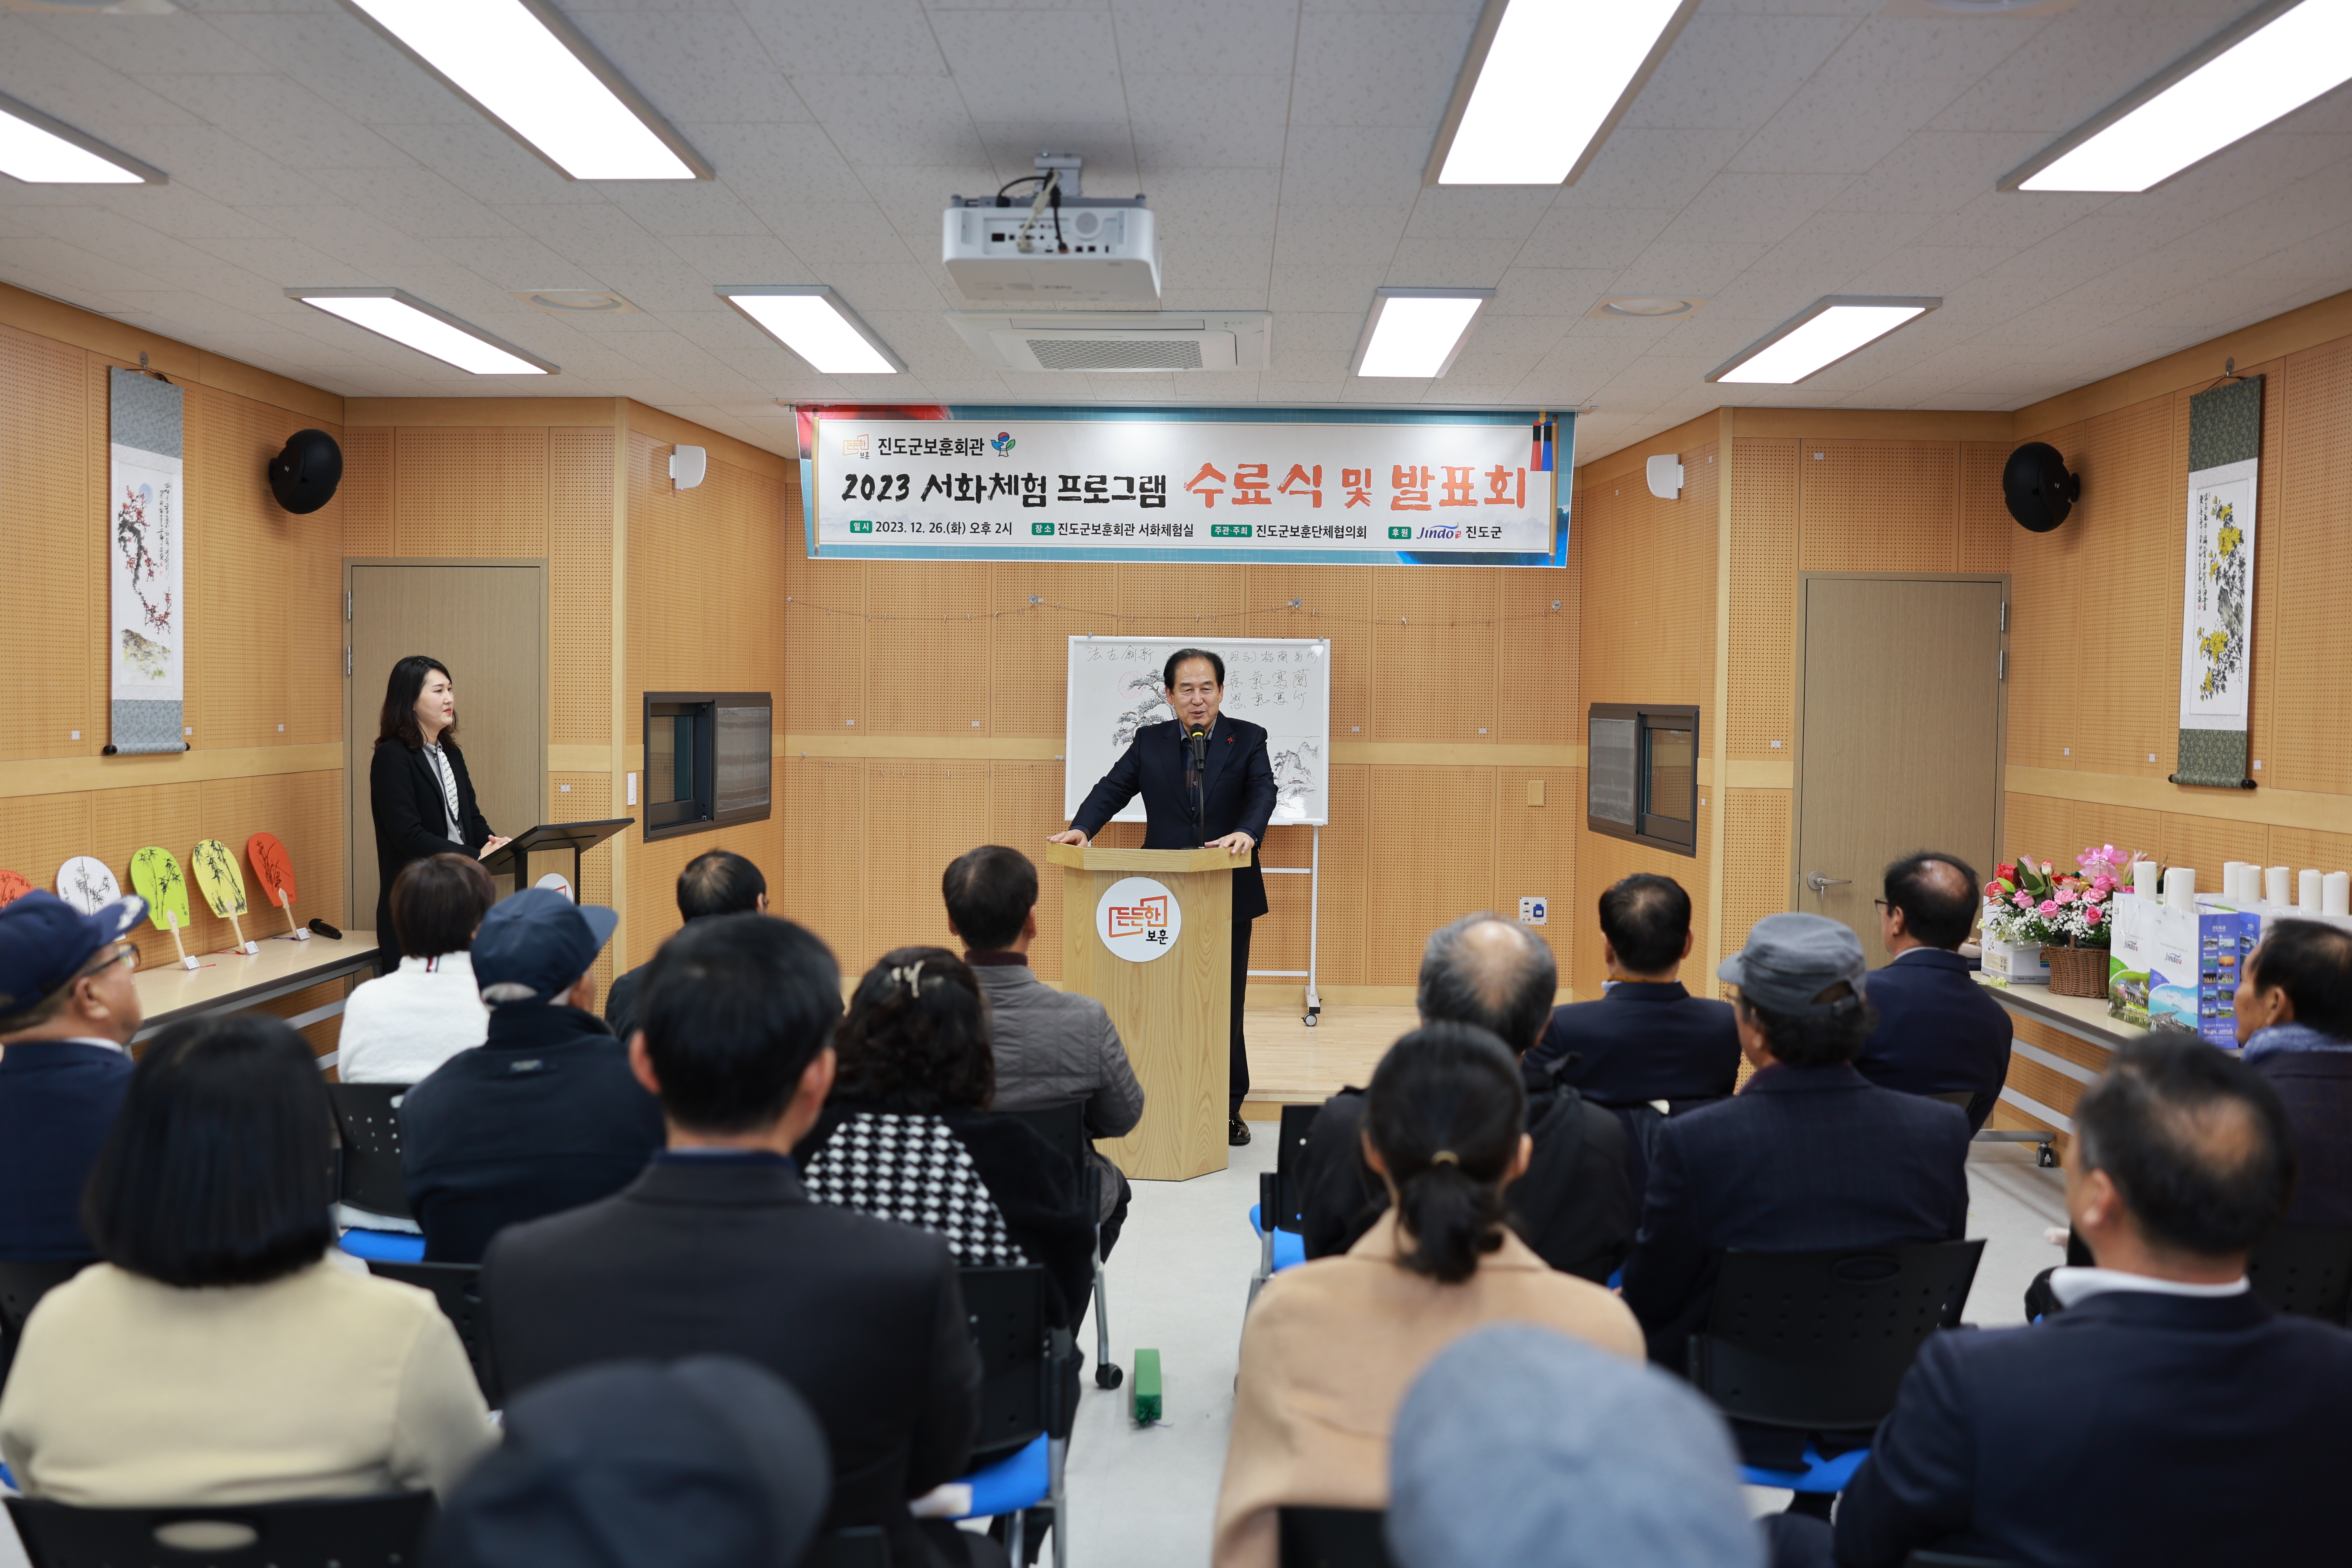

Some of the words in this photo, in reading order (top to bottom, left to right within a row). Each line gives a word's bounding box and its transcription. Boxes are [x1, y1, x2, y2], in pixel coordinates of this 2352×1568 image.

[878, 437, 985, 456] 진도군보훈회관
[860, 451, 869, 459] 보훈
[841, 473, 910, 503] 2023
[920, 472, 1047, 508] 서화체험
[1057, 474, 1166, 508] 프로그램
[1183, 463, 1323, 509] 수료식
[1341, 468, 1372, 509] 및
[1391, 464, 1526, 511] 발표회
[876, 521, 906, 533] 2023.
[911, 522, 925, 533] 12.
[929, 521, 965, 535] 26.(화)
[969, 522, 991, 535] 오후
[995, 522, 1012, 535] 2시
[1058, 523, 1135, 536] 진도군보훈회관
[1139, 523, 1194, 537] 서화체험실
[1256, 524, 1367, 539] 진도군보훈단체협의회
[1416, 526, 1454, 539] Jindo
[1466, 526, 1503, 539] 진도군
[1146, 929, 1168, 945] 보훈
[2124, 940, 2136, 951] Jindo
[2164, 953, 2179, 964] Jindo
